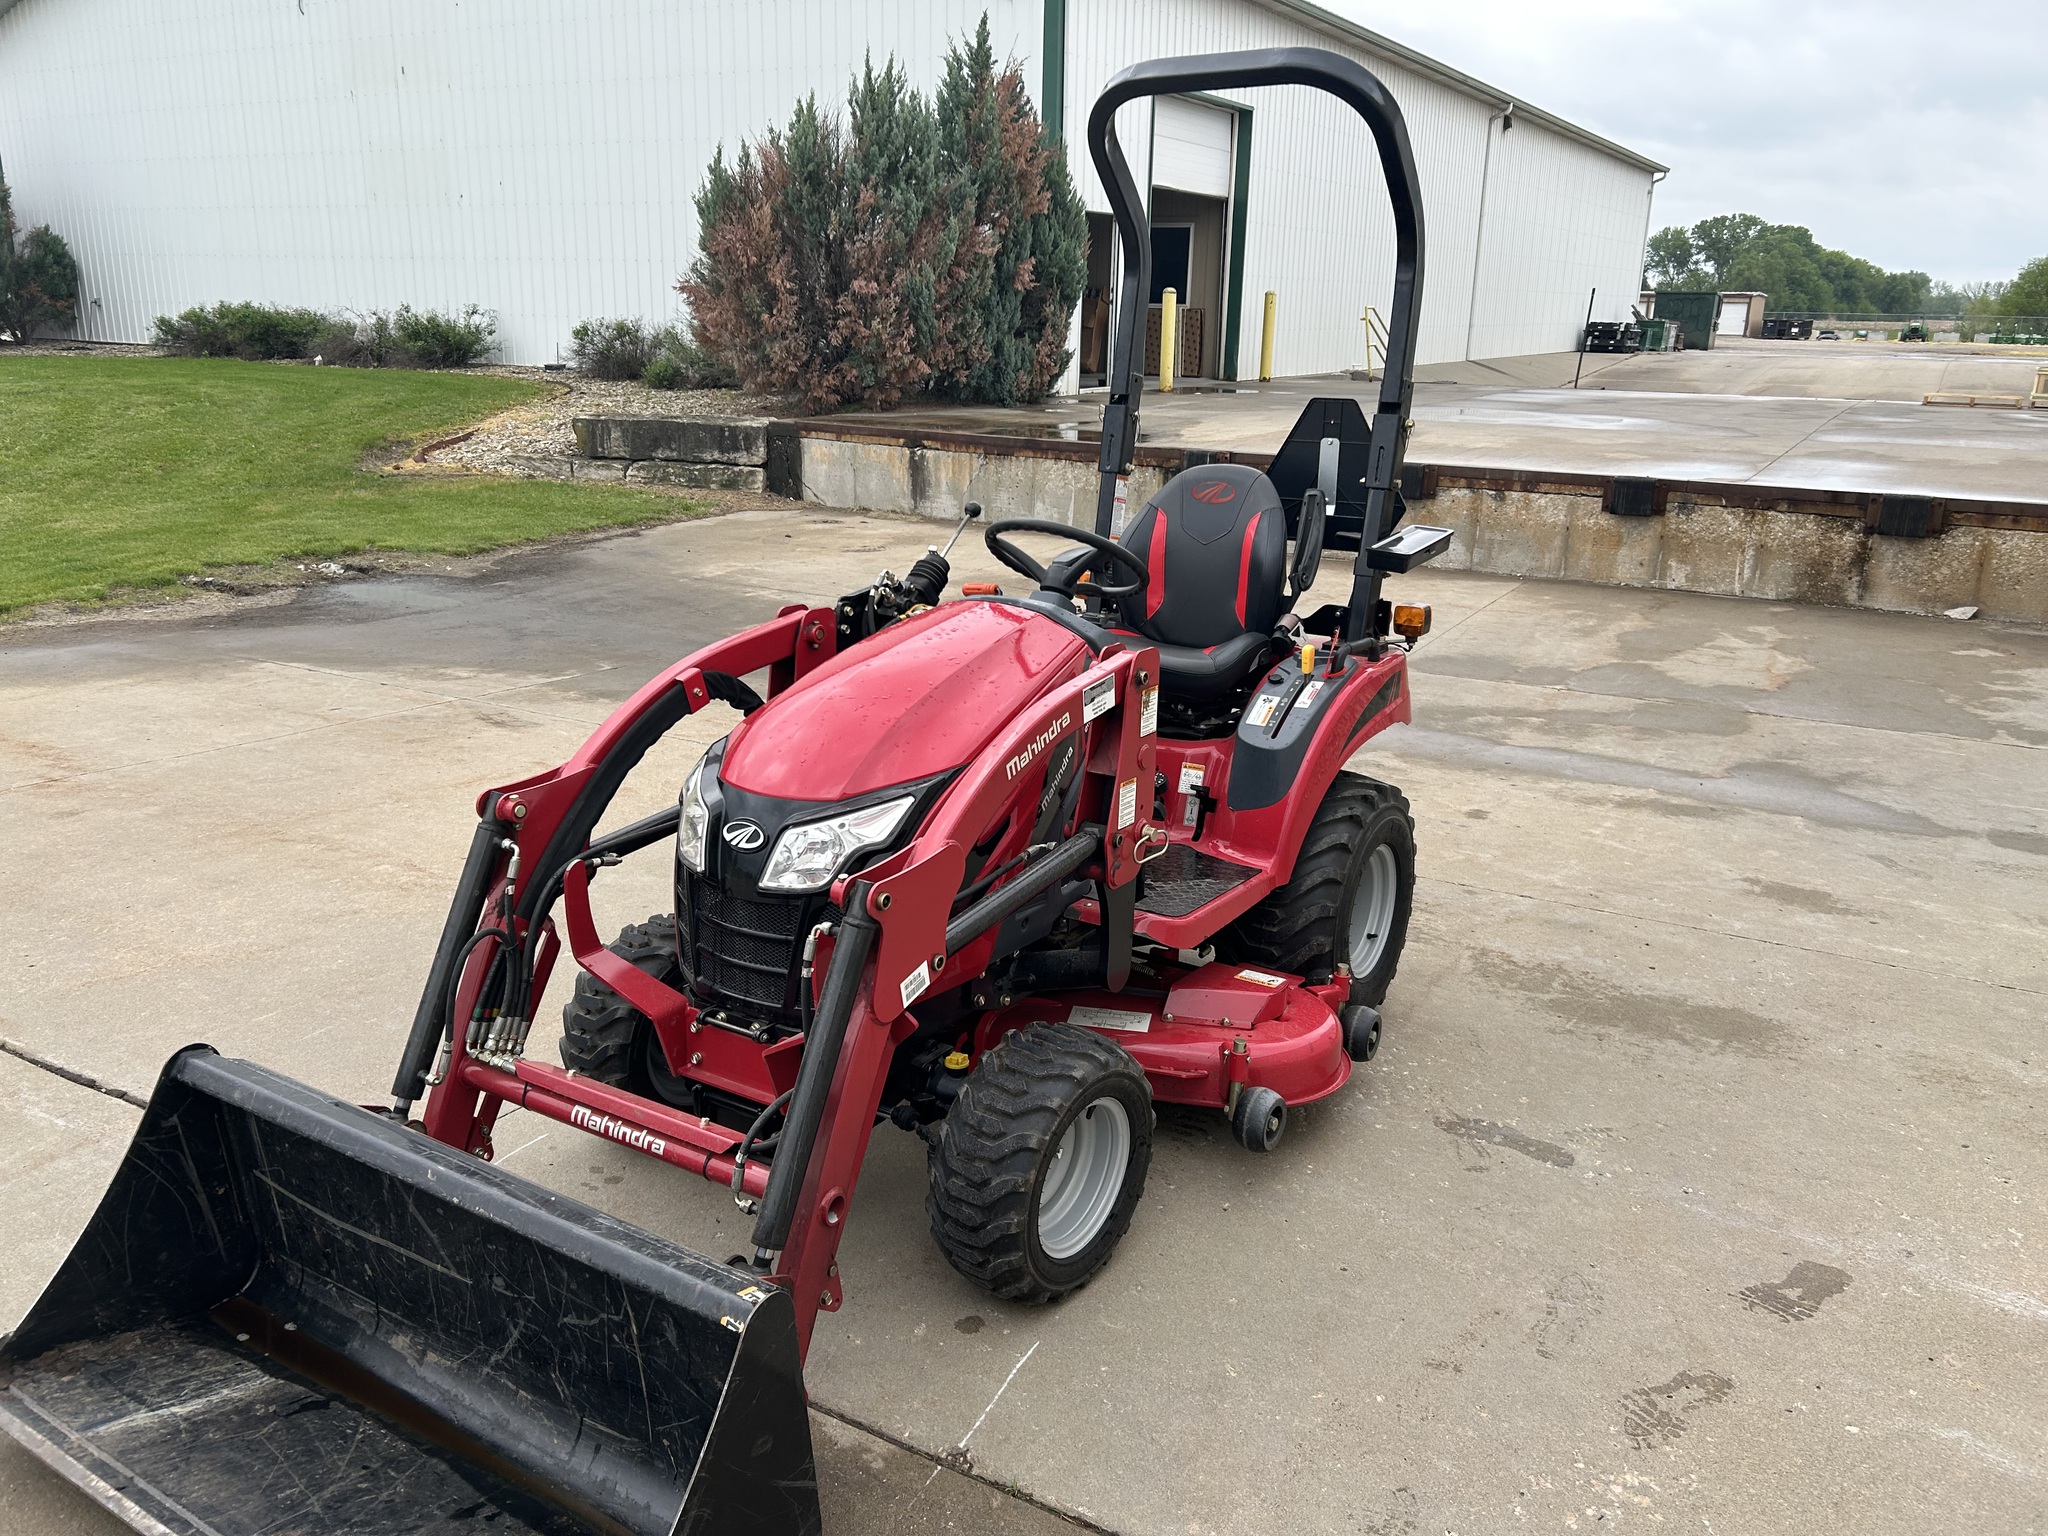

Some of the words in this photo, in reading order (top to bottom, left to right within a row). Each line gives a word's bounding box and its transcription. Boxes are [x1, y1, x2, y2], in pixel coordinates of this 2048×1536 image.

[1006, 712, 1071, 781] Mahindra
[1041, 746, 1074, 812] Mahindra
[570, 1104, 666, 1156] Mahindra
